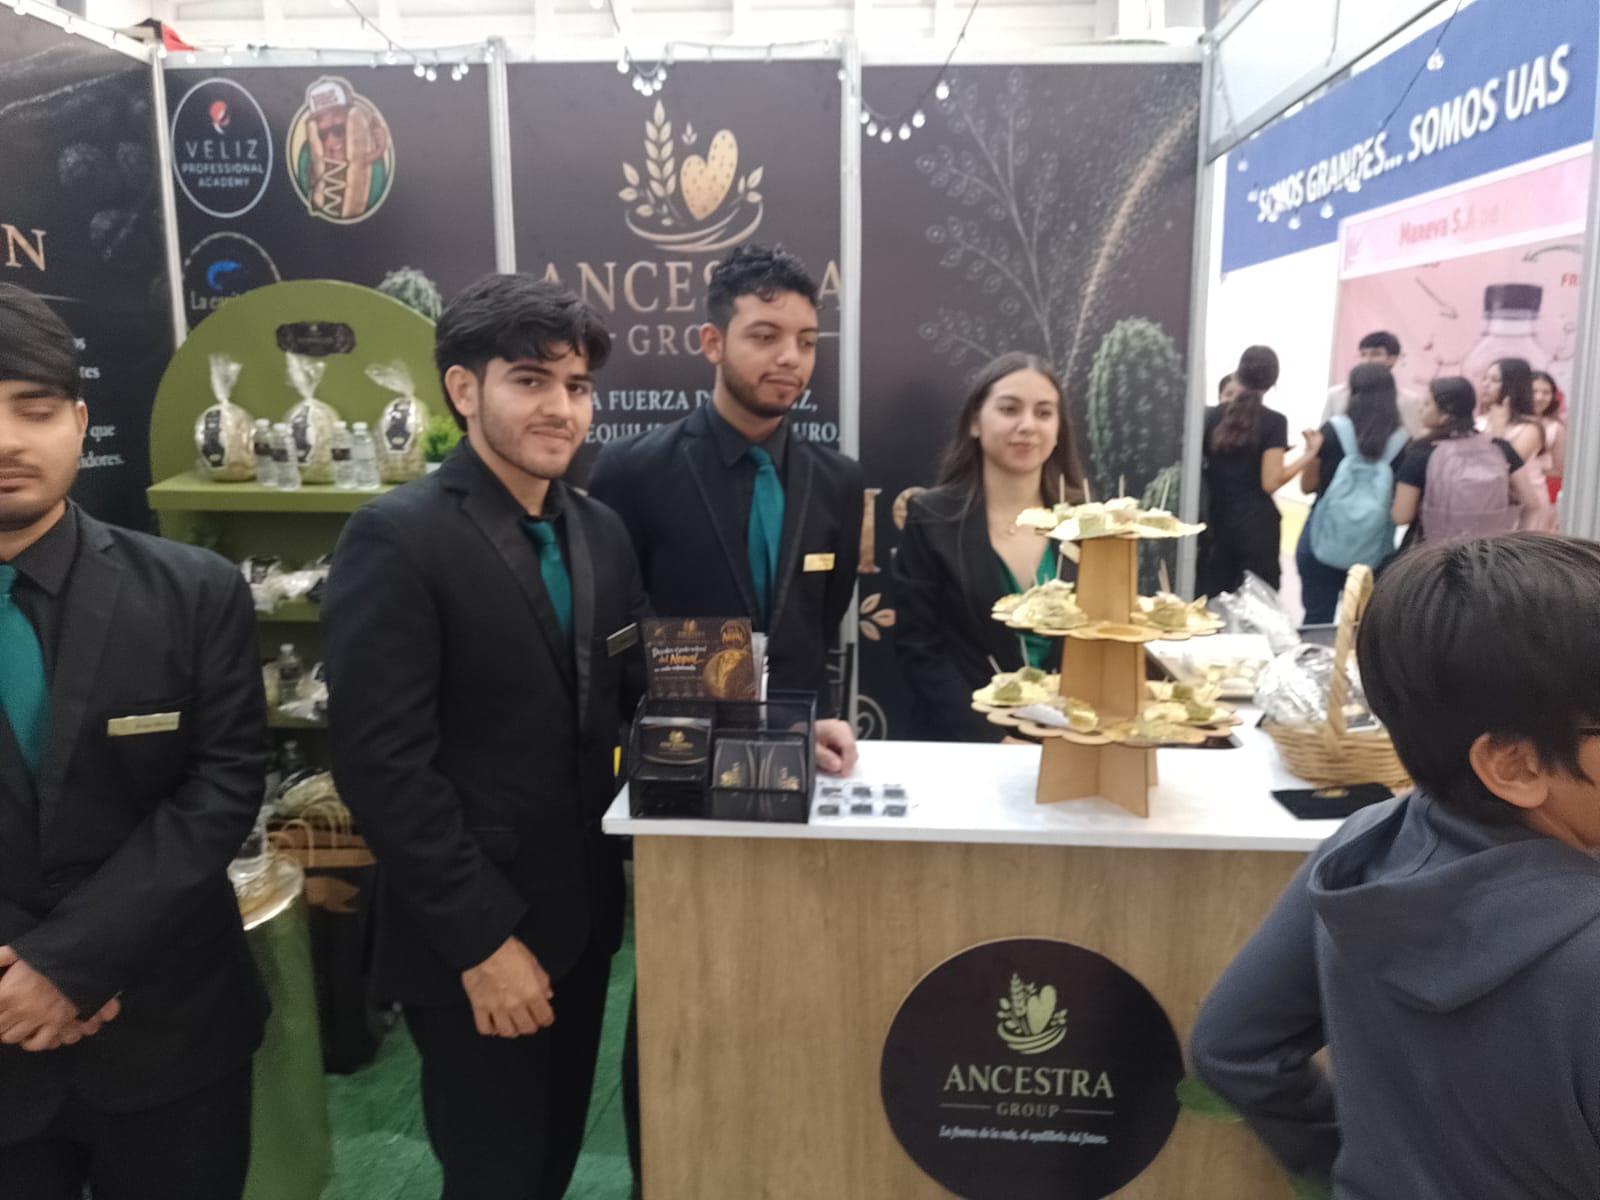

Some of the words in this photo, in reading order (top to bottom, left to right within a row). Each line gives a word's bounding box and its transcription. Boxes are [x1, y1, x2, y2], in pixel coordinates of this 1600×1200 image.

[1407, 77, 1500, 162] SOMOS
[1505, 43, 1570, 121] UAS
[185, 139, 258, 159] VELIZ
[182, 162, 264, 174] PROFESSIONAL
[198, 176, 250, 188] ACADEMY
[628, 323, 702, 356] GRO
[608, 390, 689, 411] FUERZA
[943, 1064, 1115, 1099] ANCESTRA
[996, 1102, 1060, 1118] GROUP
